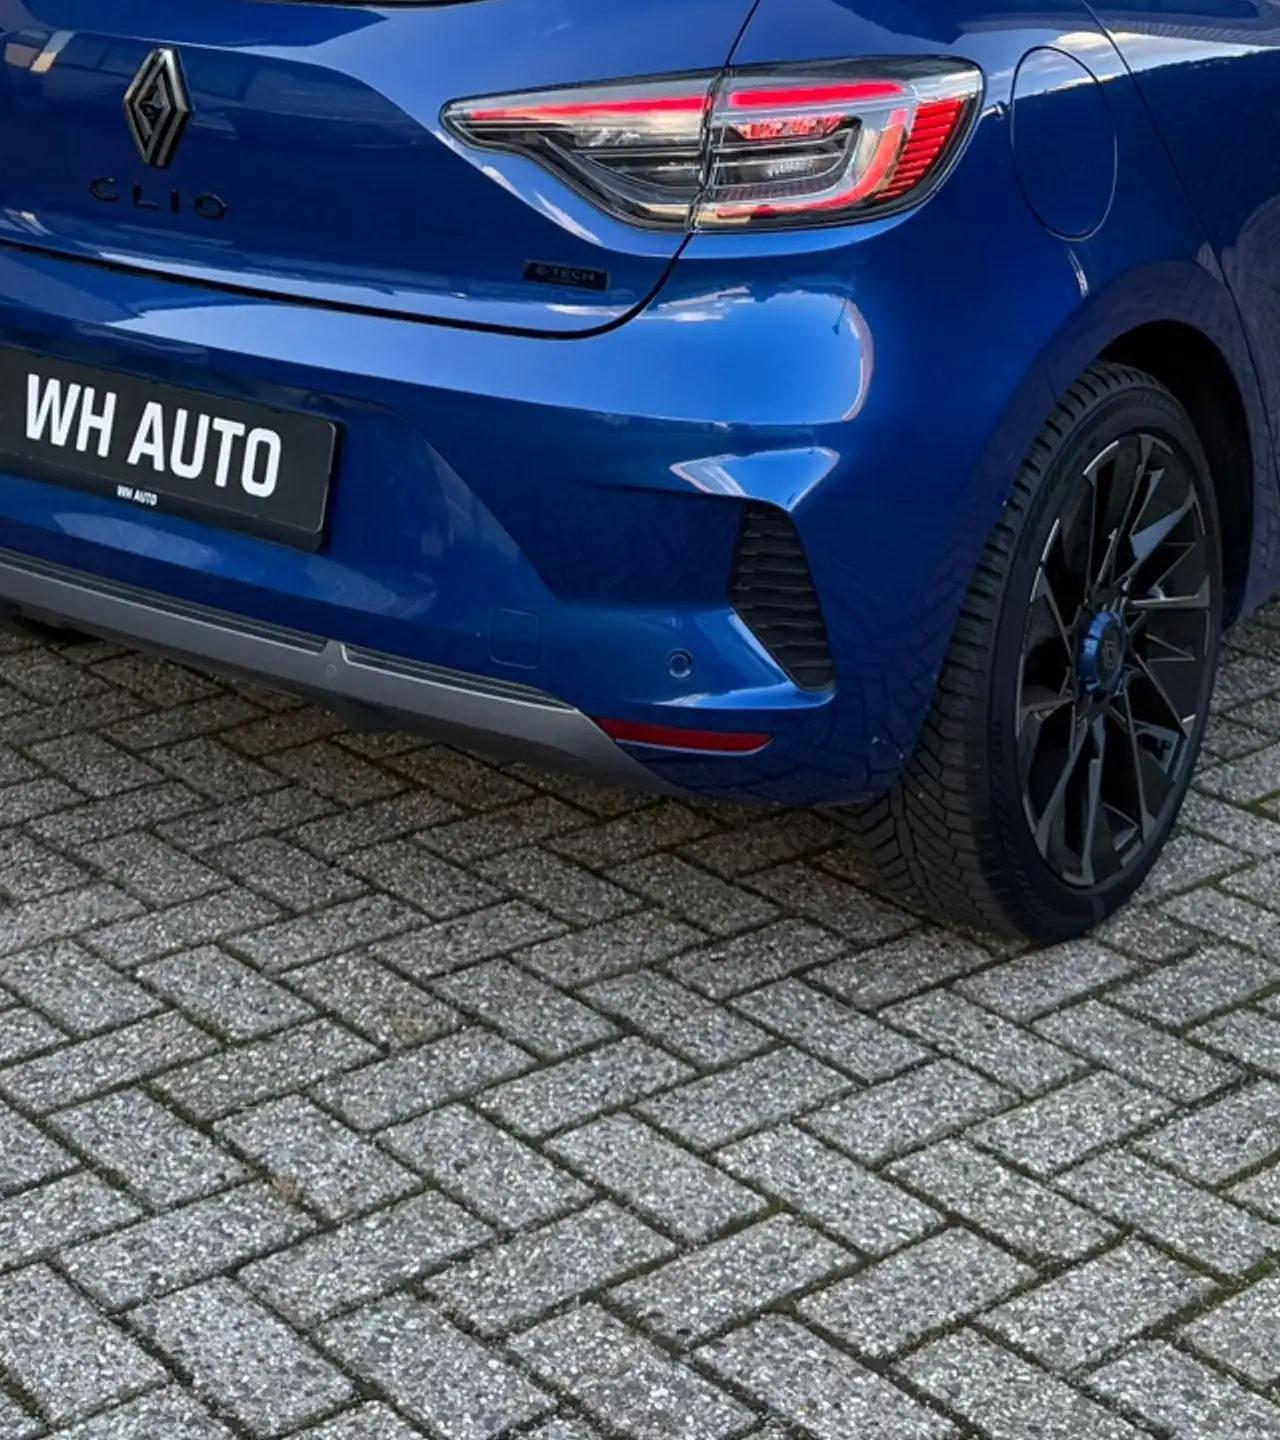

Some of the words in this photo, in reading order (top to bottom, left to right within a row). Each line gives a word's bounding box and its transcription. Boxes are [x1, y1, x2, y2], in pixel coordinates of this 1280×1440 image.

[90, 177, 228, 220] CLIO
[25, 373, 117, 458] WH
[126, 401, 282, 498] AUTO
[116, 484, 133, 500] WH
[133, 489, 158, 506] AUTO
